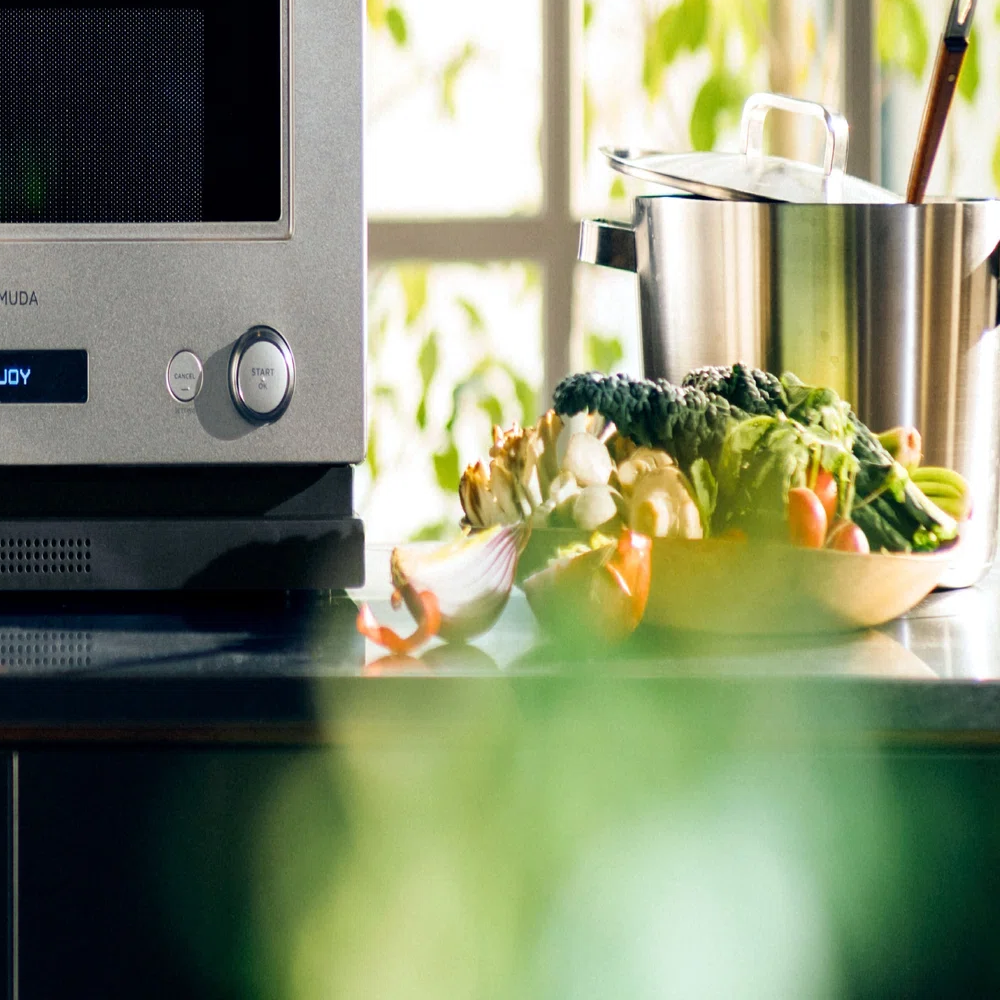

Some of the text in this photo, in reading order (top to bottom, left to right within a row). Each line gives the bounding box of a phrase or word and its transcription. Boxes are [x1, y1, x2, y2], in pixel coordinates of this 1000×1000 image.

[173, 372, 197, 380] CANCEL
[251, 367, 275, 377] START
[257, 382, 268, 390] OK
